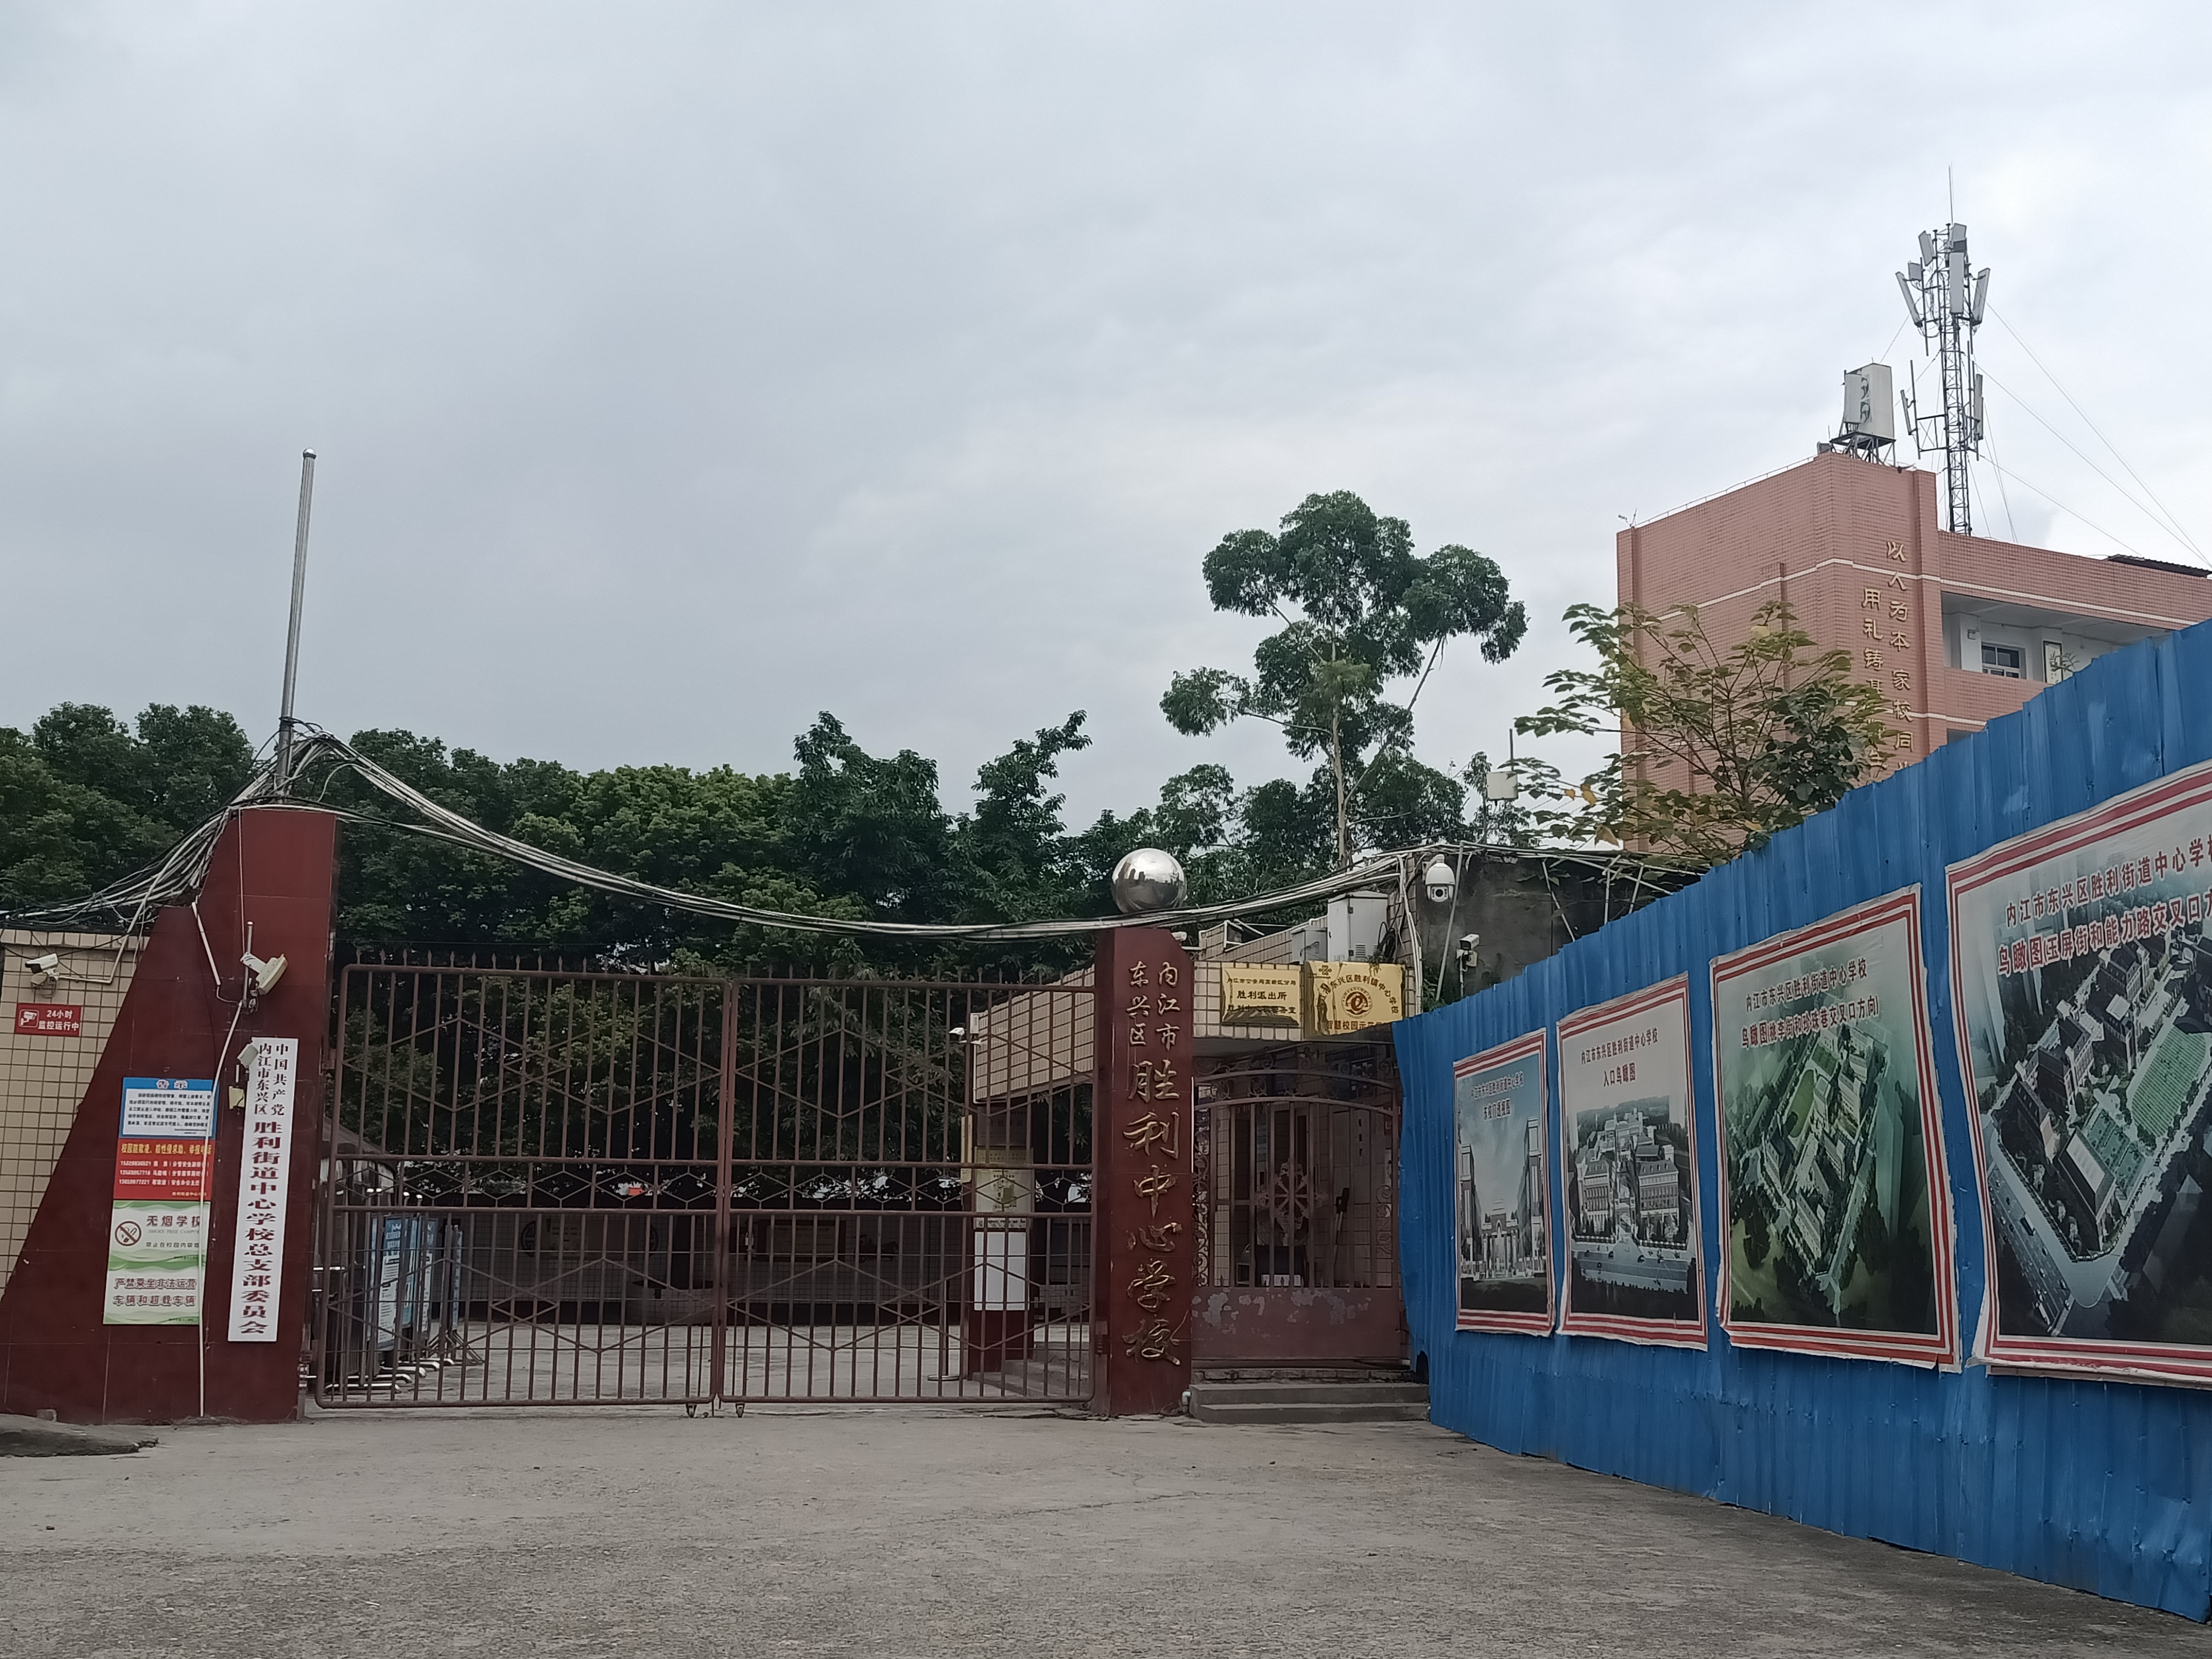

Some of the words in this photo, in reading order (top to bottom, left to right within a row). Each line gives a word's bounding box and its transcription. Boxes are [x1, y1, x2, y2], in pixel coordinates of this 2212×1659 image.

[1126, 961, 1151, 1046] 东兴区
[1237, 990, 1287, 1000] 胜利派出所
[1745, 958, 1867, 1013] 内江市东兴区胜利街道中心学校
[47, 1010, 72, 1019] 24小时
[1156, 962, 1180, 1051] 内江市
[38, 1020, 79, 1031] 监控运行中
[1581, 1028, 1659, 1065] 内江市东兴区胜利街道中心学校
[254, 1043, 272, 1115] 内江市东兴区
[271, 1044, 289, 1116] 中国共产党
[1603, 1062, 1636, 1087] 入口鸟瞰图
[238, 1121, 283, 1334] 胜利街道中心学校总支部委员会
[113, 1295, 196, 1307] 车辆和超载车辆
[114, 1278, 197, 1290] 严禁乘坐非法运营
